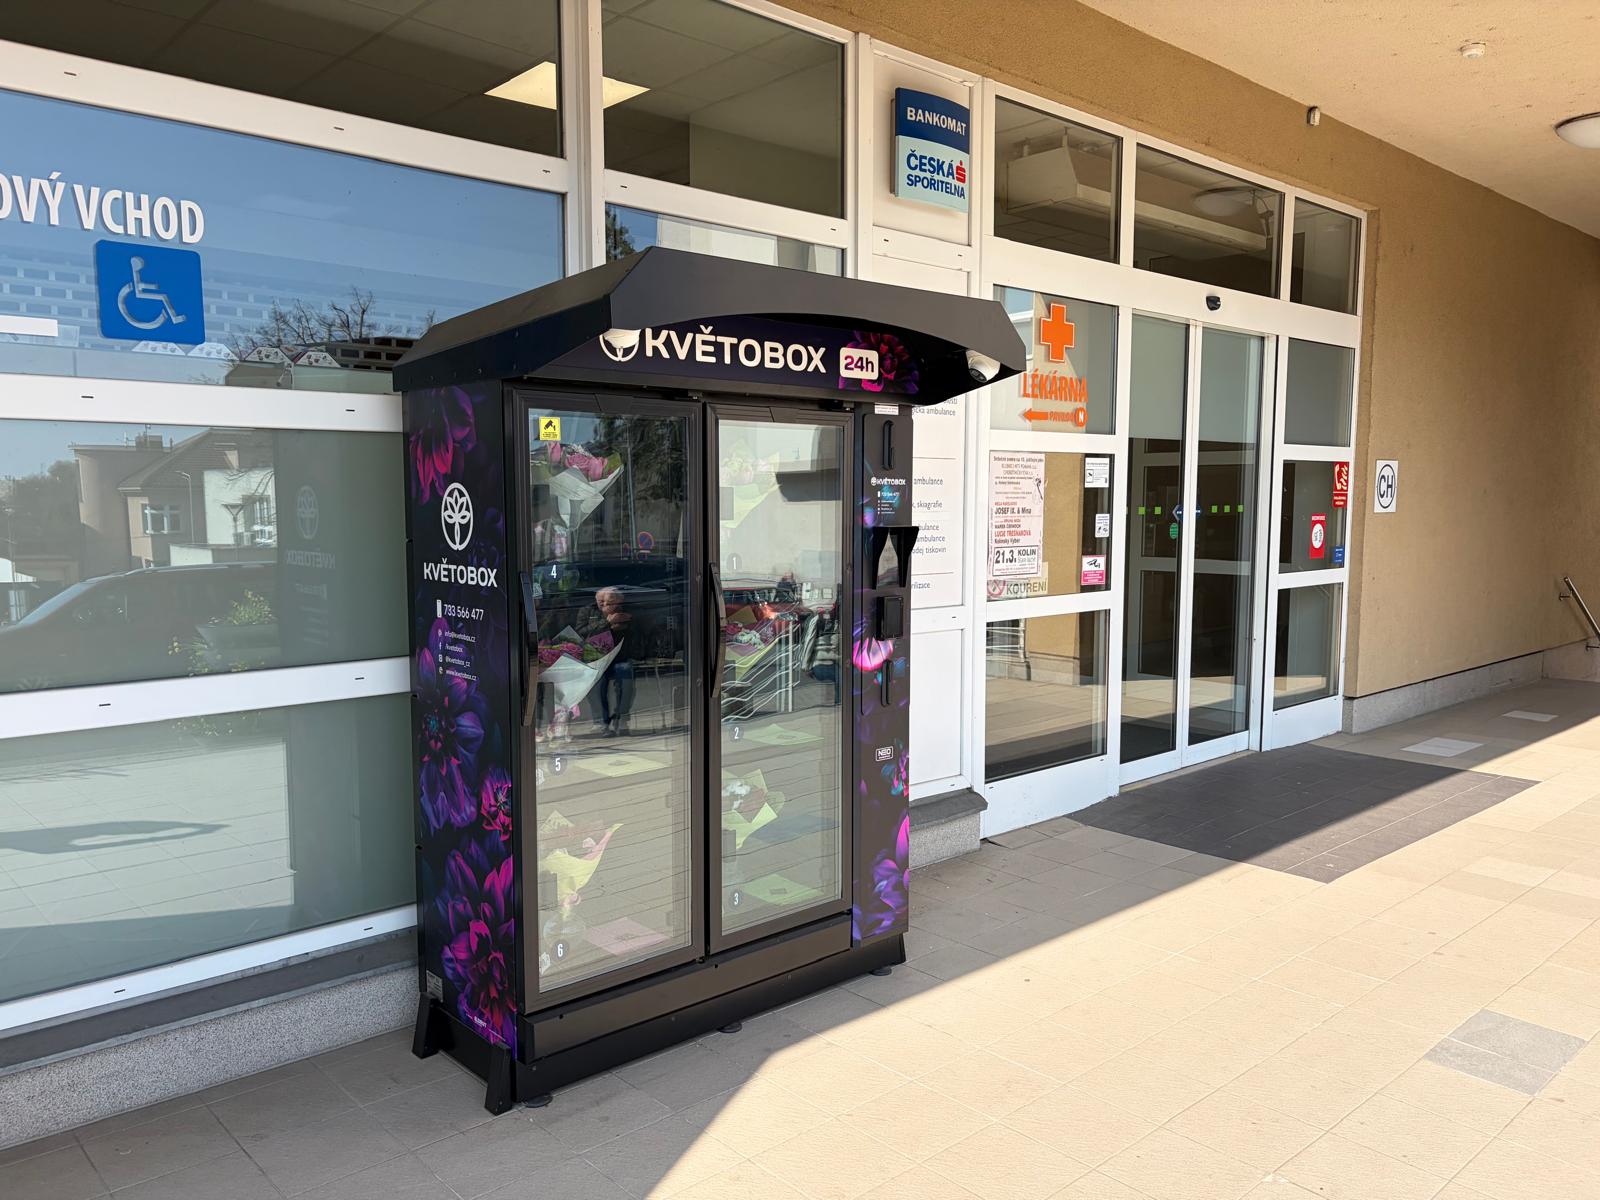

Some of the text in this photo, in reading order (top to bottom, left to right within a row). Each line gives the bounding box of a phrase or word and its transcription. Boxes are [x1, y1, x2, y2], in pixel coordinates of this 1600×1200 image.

[907, 106, 966, 136] BANKOMAT
[906, 149, 955, 180] ČESKÁ
[906, 174, 966, 199] SPOŘITELNA
[73, 183, 205, 244] VCHOD
[645, 325, 875, 374] KVĚTOBOX 24h
[1022, 368, 1089, 404] LÉKÁRNA
[926, 406, 956, 416] ambulance
[913, 476, 944, 486] ambulance
[1379, 475, 1394, 499] CH
[995, 550, 1017, 564] 21.3.
[423, 557, 498, 588] KVĚTOBOX
[550, 565, 557, 579] 4
[443, 604, 484, 621] 733 566 477
[734, 728, 739, 739] 2
[555, 758, 561, 771] 5
[734, 893, 739, 905] 3
[557, 944, 563, 957] 6
